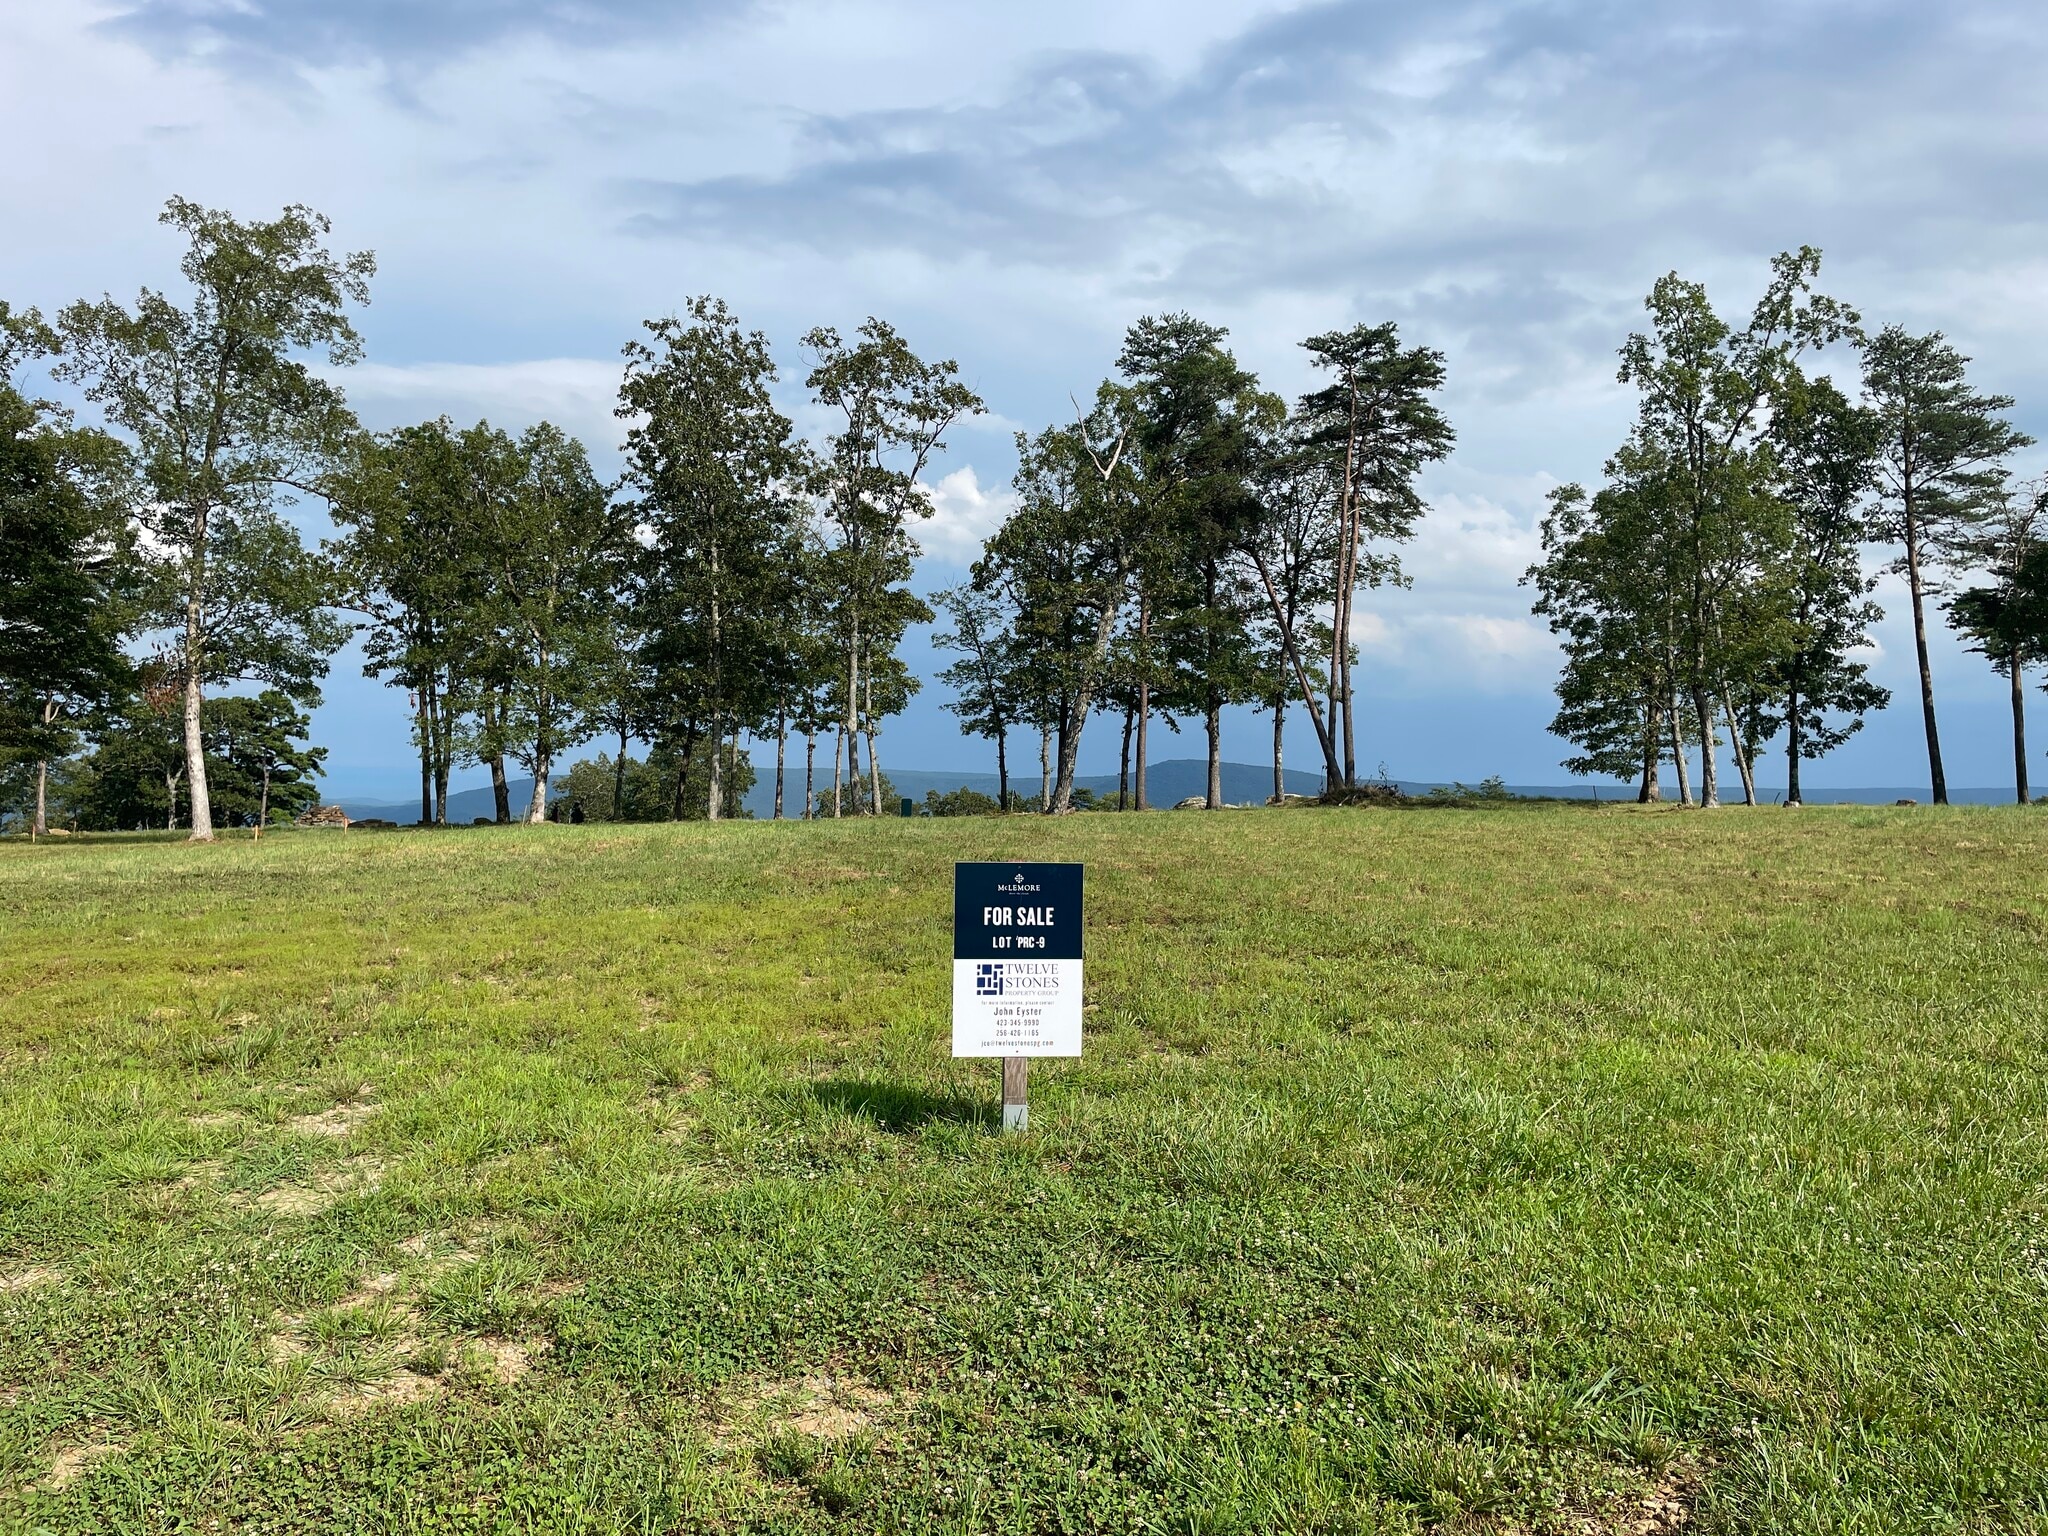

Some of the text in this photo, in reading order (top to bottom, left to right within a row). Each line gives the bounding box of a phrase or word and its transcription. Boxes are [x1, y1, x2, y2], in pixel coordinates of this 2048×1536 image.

[983, 906, 1055, 926] FOR SALE
[992, 936, 1012, 949] LOT
[1005, 963, 1059, 975] TWELVE
[1005, 976, 1060, 988] STONES
[993, 1007, 1042, 1018] John Eyster
[996, 1019, 1040, 1027] 423-345-9990
